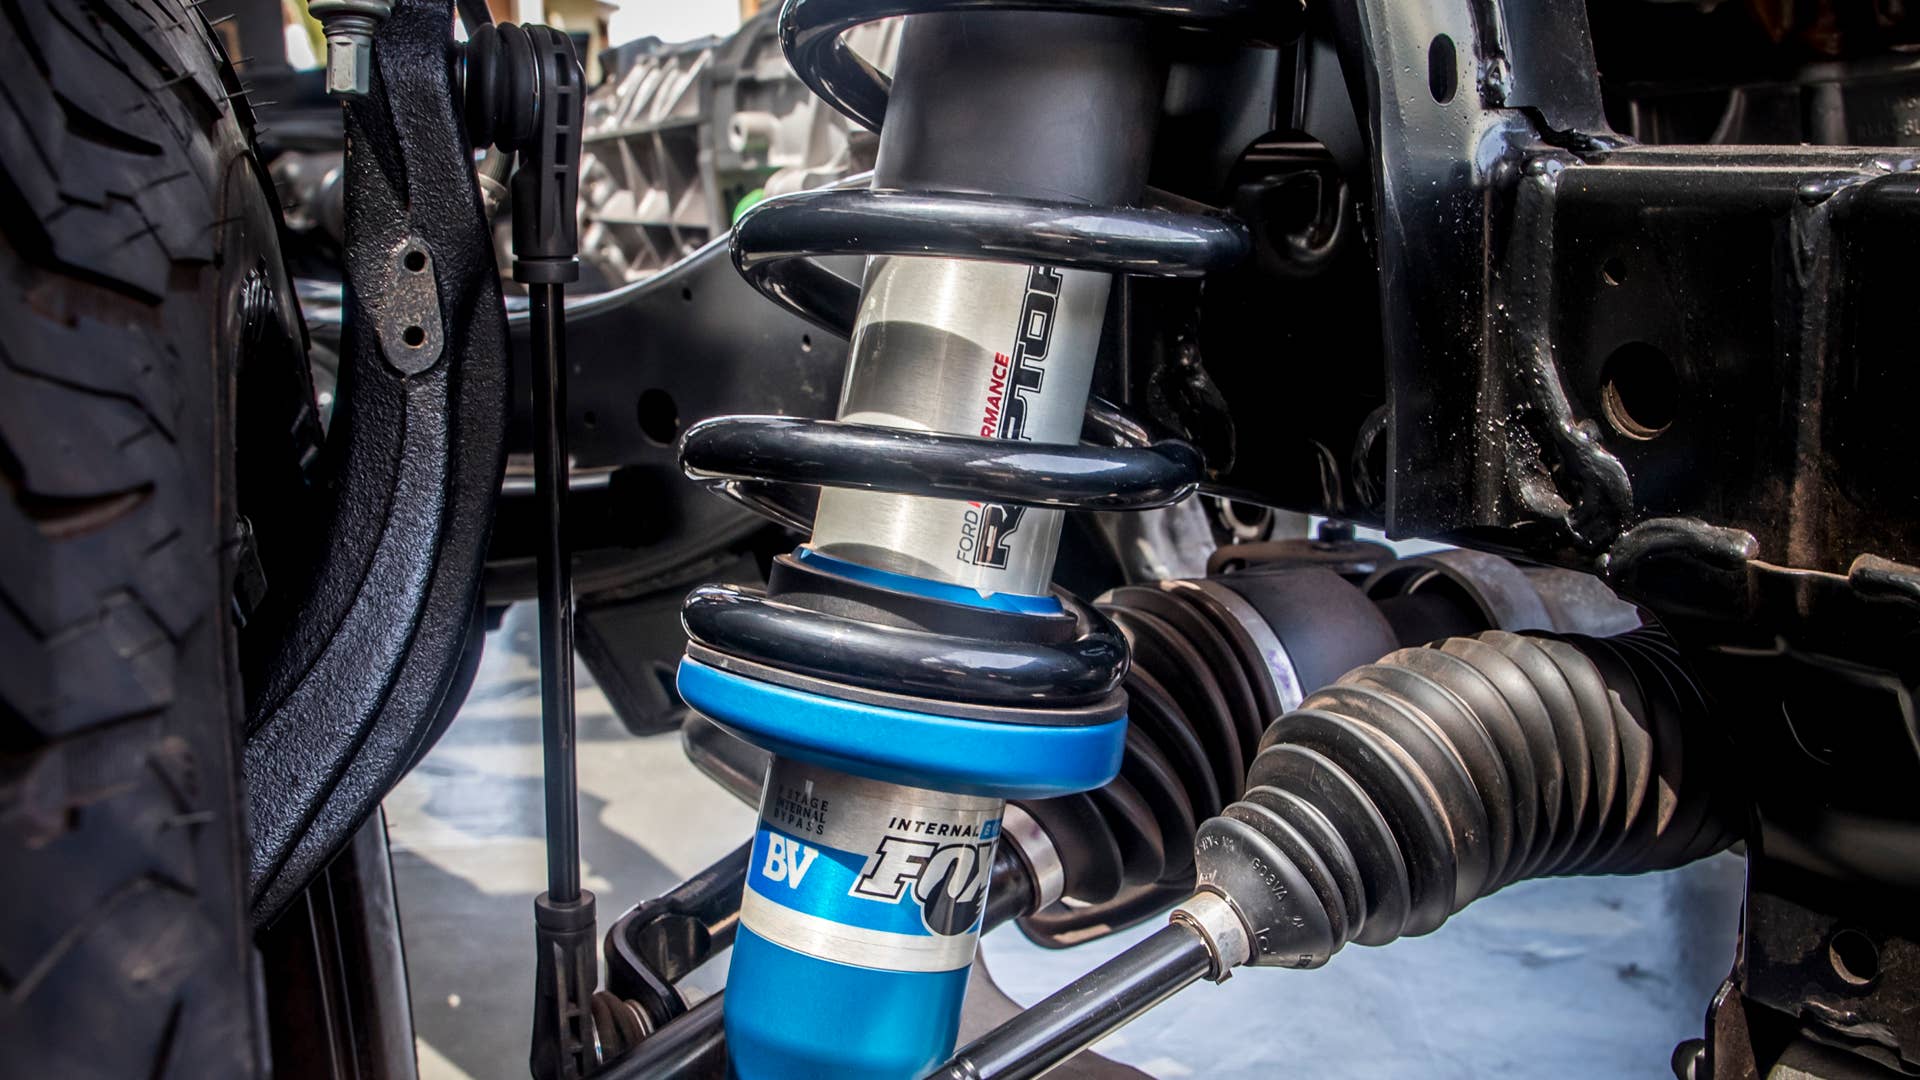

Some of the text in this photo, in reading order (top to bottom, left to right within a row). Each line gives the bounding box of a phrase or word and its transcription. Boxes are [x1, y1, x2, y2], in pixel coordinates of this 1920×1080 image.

[957, 510, 979, 564] FORD
[888, 816, 979, 838] INTERNAL
[762, 832, 819, 890] BV
